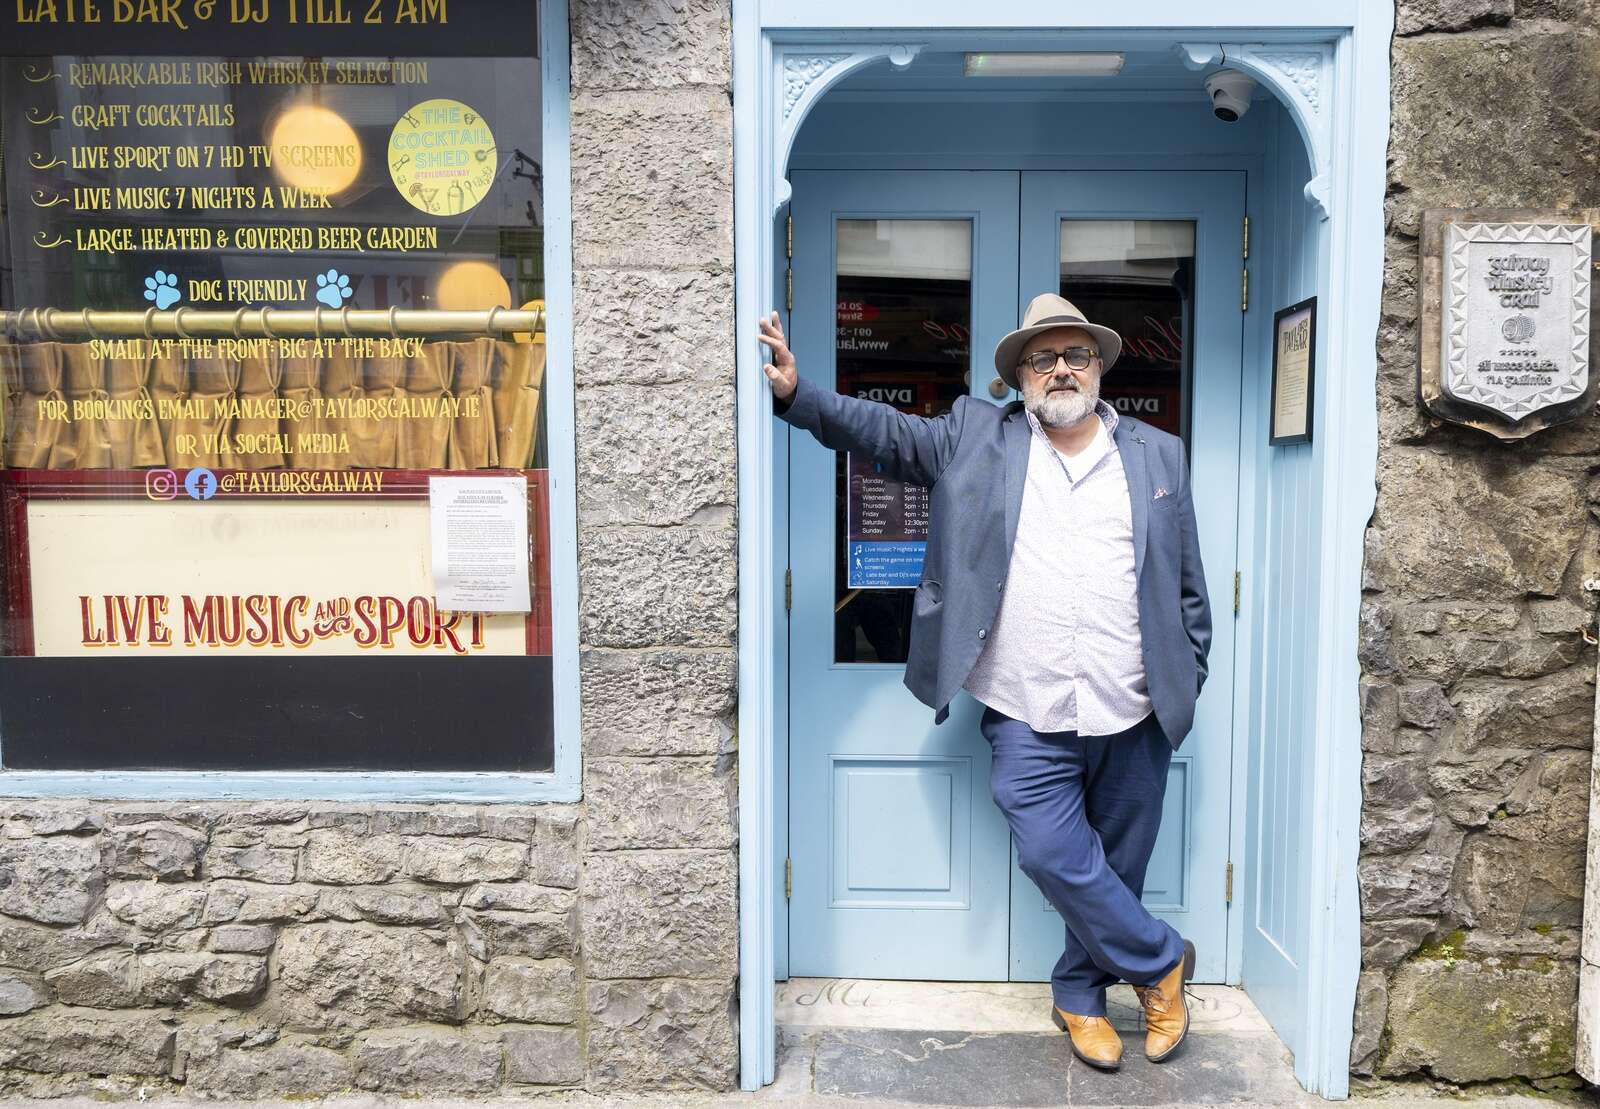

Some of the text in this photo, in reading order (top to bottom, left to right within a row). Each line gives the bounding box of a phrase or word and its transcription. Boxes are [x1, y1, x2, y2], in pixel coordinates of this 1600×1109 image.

[16, 0, 448, 30] LATE BAR & DJ TILL 2 AM
[69, 61, 428, 88] REMARKABLE IRISH WHISKEY SELECTION
[72, 103, 235, 130] CRAFT COCKTAILS
[421, 107, 461, 126] THE
[392, 127, 491, 150] COCKTAIL
[71, 145, 356, 171] LIVE SPORT ON 7 HD TV SCREENS
[415, 149, 470, 169] SHED
[74, 186, 332, 210] LIVE MUSIC 7 NIGHTS A WEEK
[142, 228, 212, 250] HEATED
[216, 229, 229, 249] &
[234, 227, 313, 252] COVERED
[318, 227, 365, 252] BEER
[366, 227, 438, 252] GARDEN
[188, 279, 308, 304] DOG FRIENDLY
[90, 339, 145, 360] SMALL
[150, 338, 175, 360] AT
[178, 338, 214, 359] THE
[279, 338, 307, 359] BIG
[311, 338, 336, 359] AT
[341, 338, 375, 358] THE
[379, 337, 427, 358] BACK
[38, 397, 480, 424] FOR BOOKINGS EMAIL MANAGER@TAYLORSGALWAY.IE
[175, 433, 350, 458] OR VIA SOCIAL MEDIA
[220, 471, 384, 494] @TAYLORSGALWAY
[79, 594, 171, 647] LIVE
[181, 594, 313, 649] MUSIC
[314, 597, 350, 621] AND
